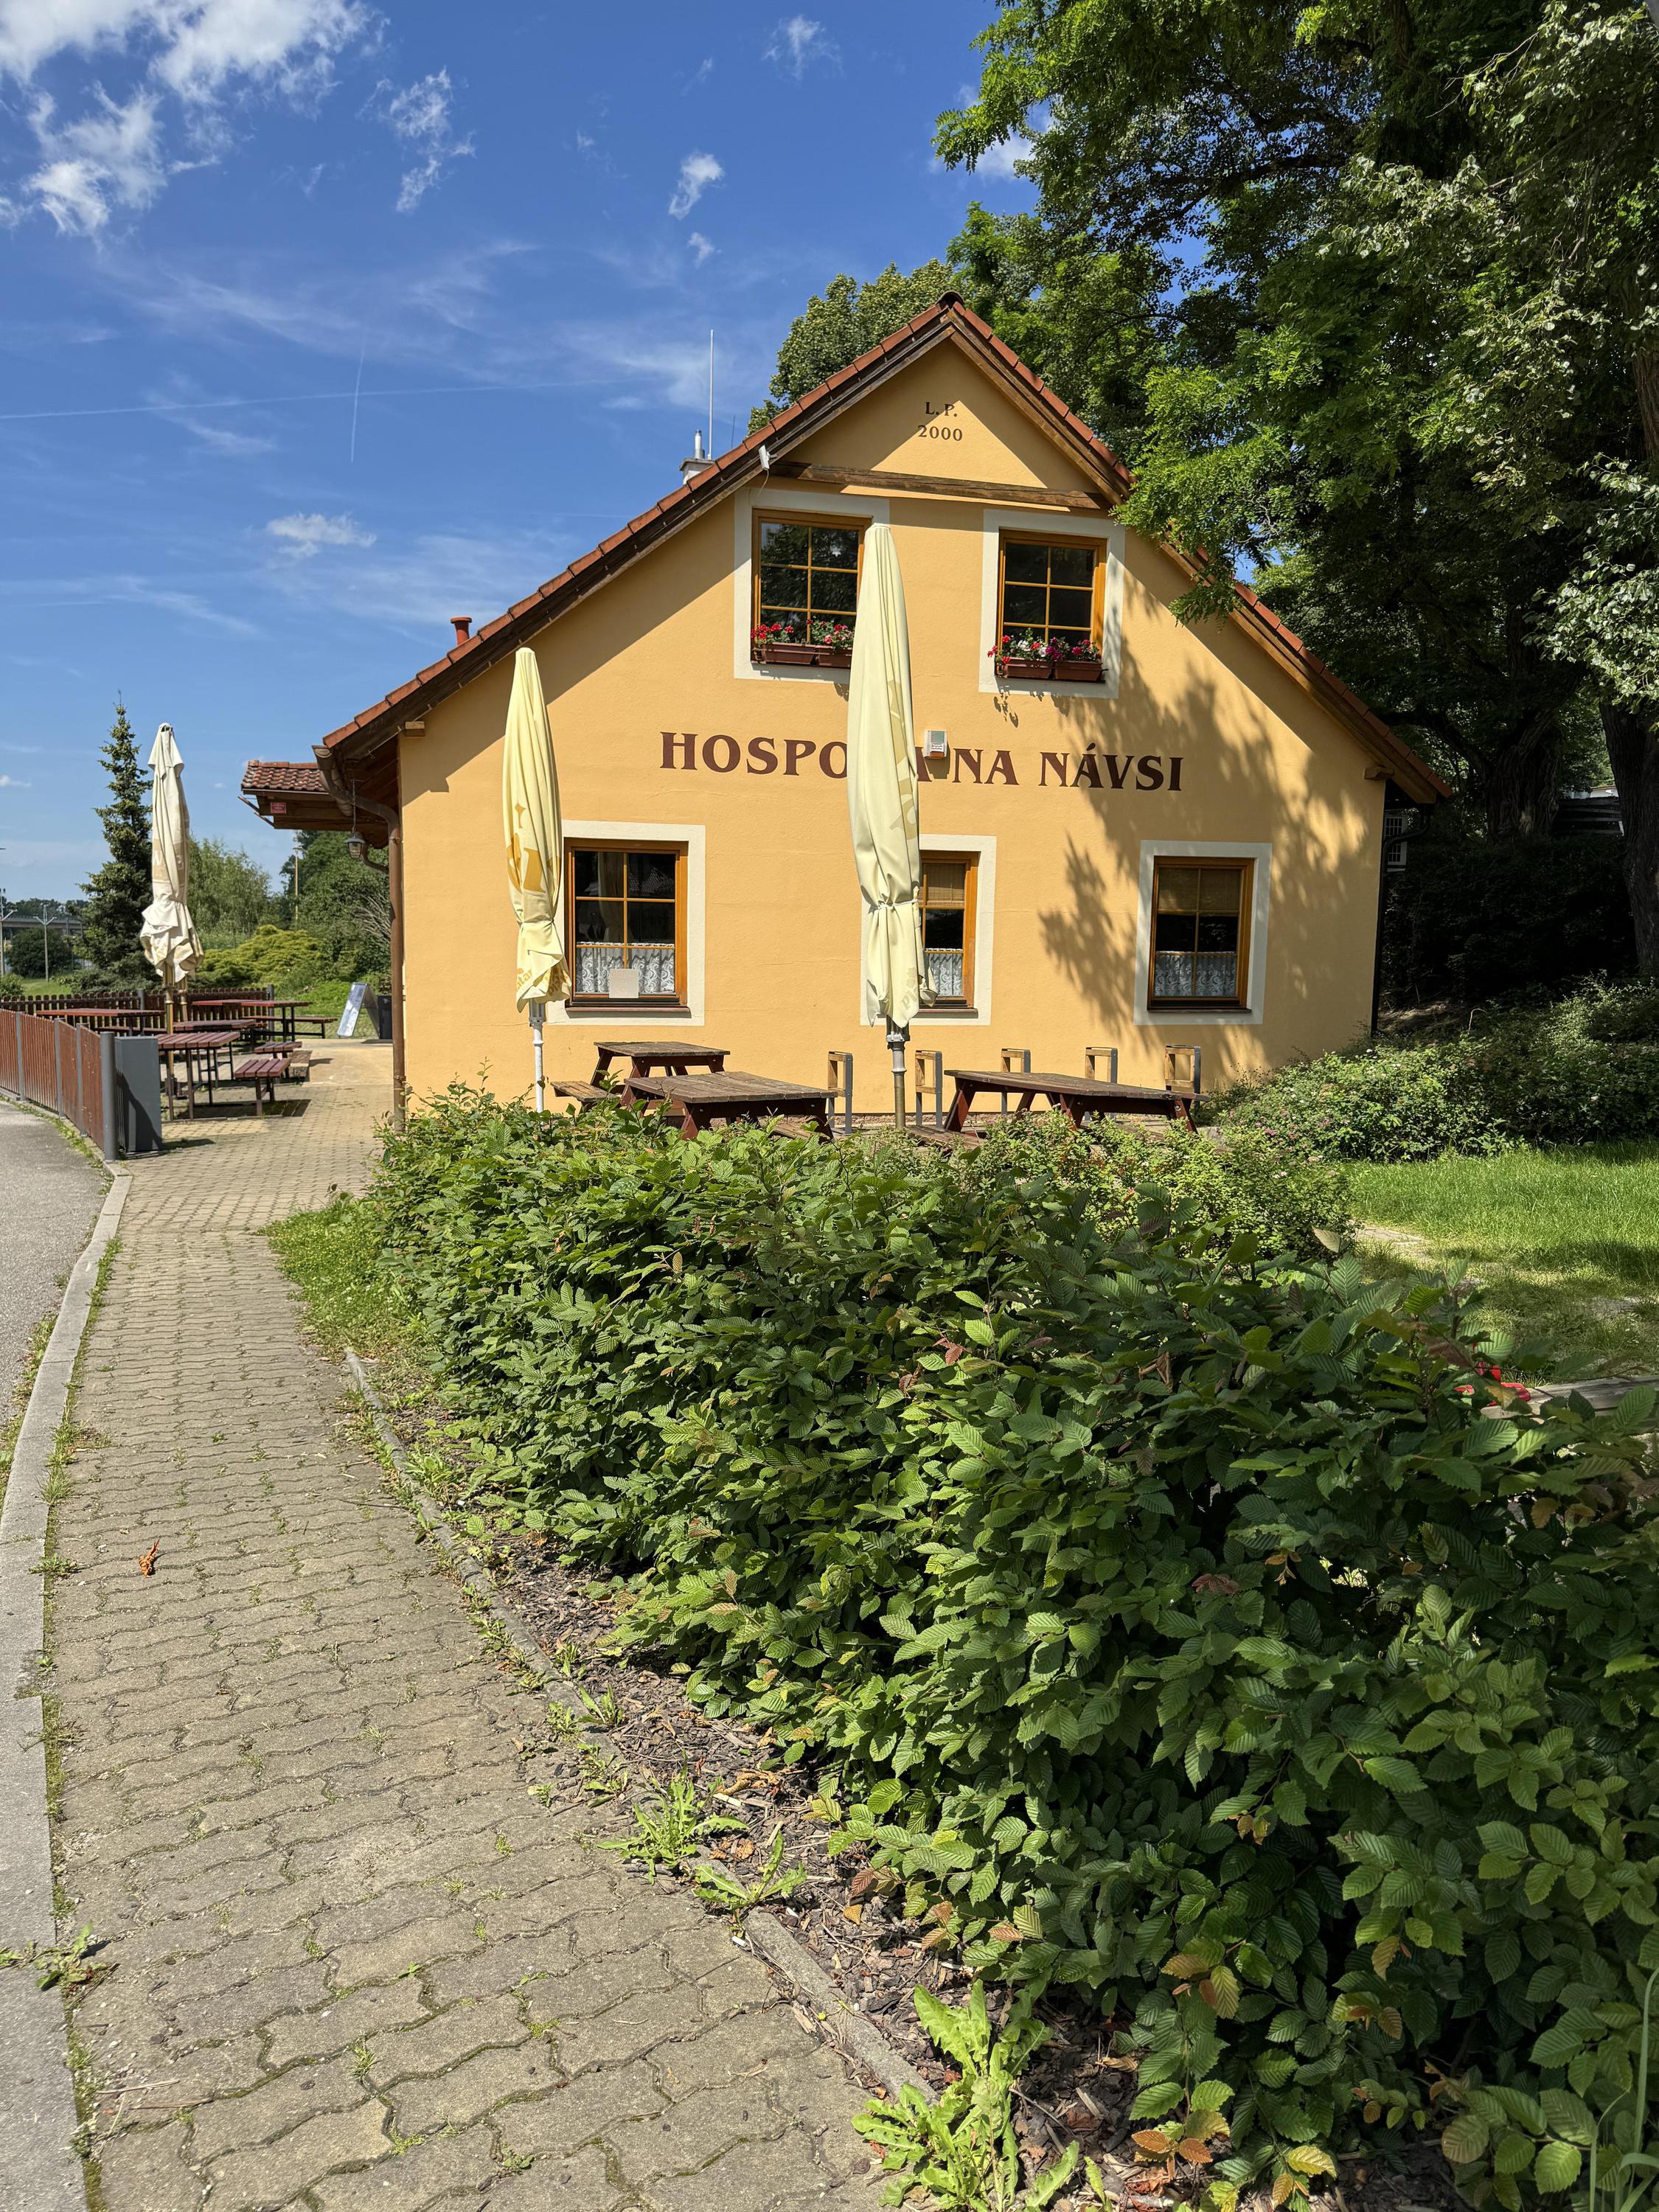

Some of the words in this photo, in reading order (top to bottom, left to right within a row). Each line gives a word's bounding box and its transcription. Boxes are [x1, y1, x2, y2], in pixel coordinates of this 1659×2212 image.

[917, 425, 963, 441] 2000
[659, 731, 932, 782] HOSPO
[951, 748, 1020, 785] NA
[1037, 742, 1184, 792] NÁVSI
